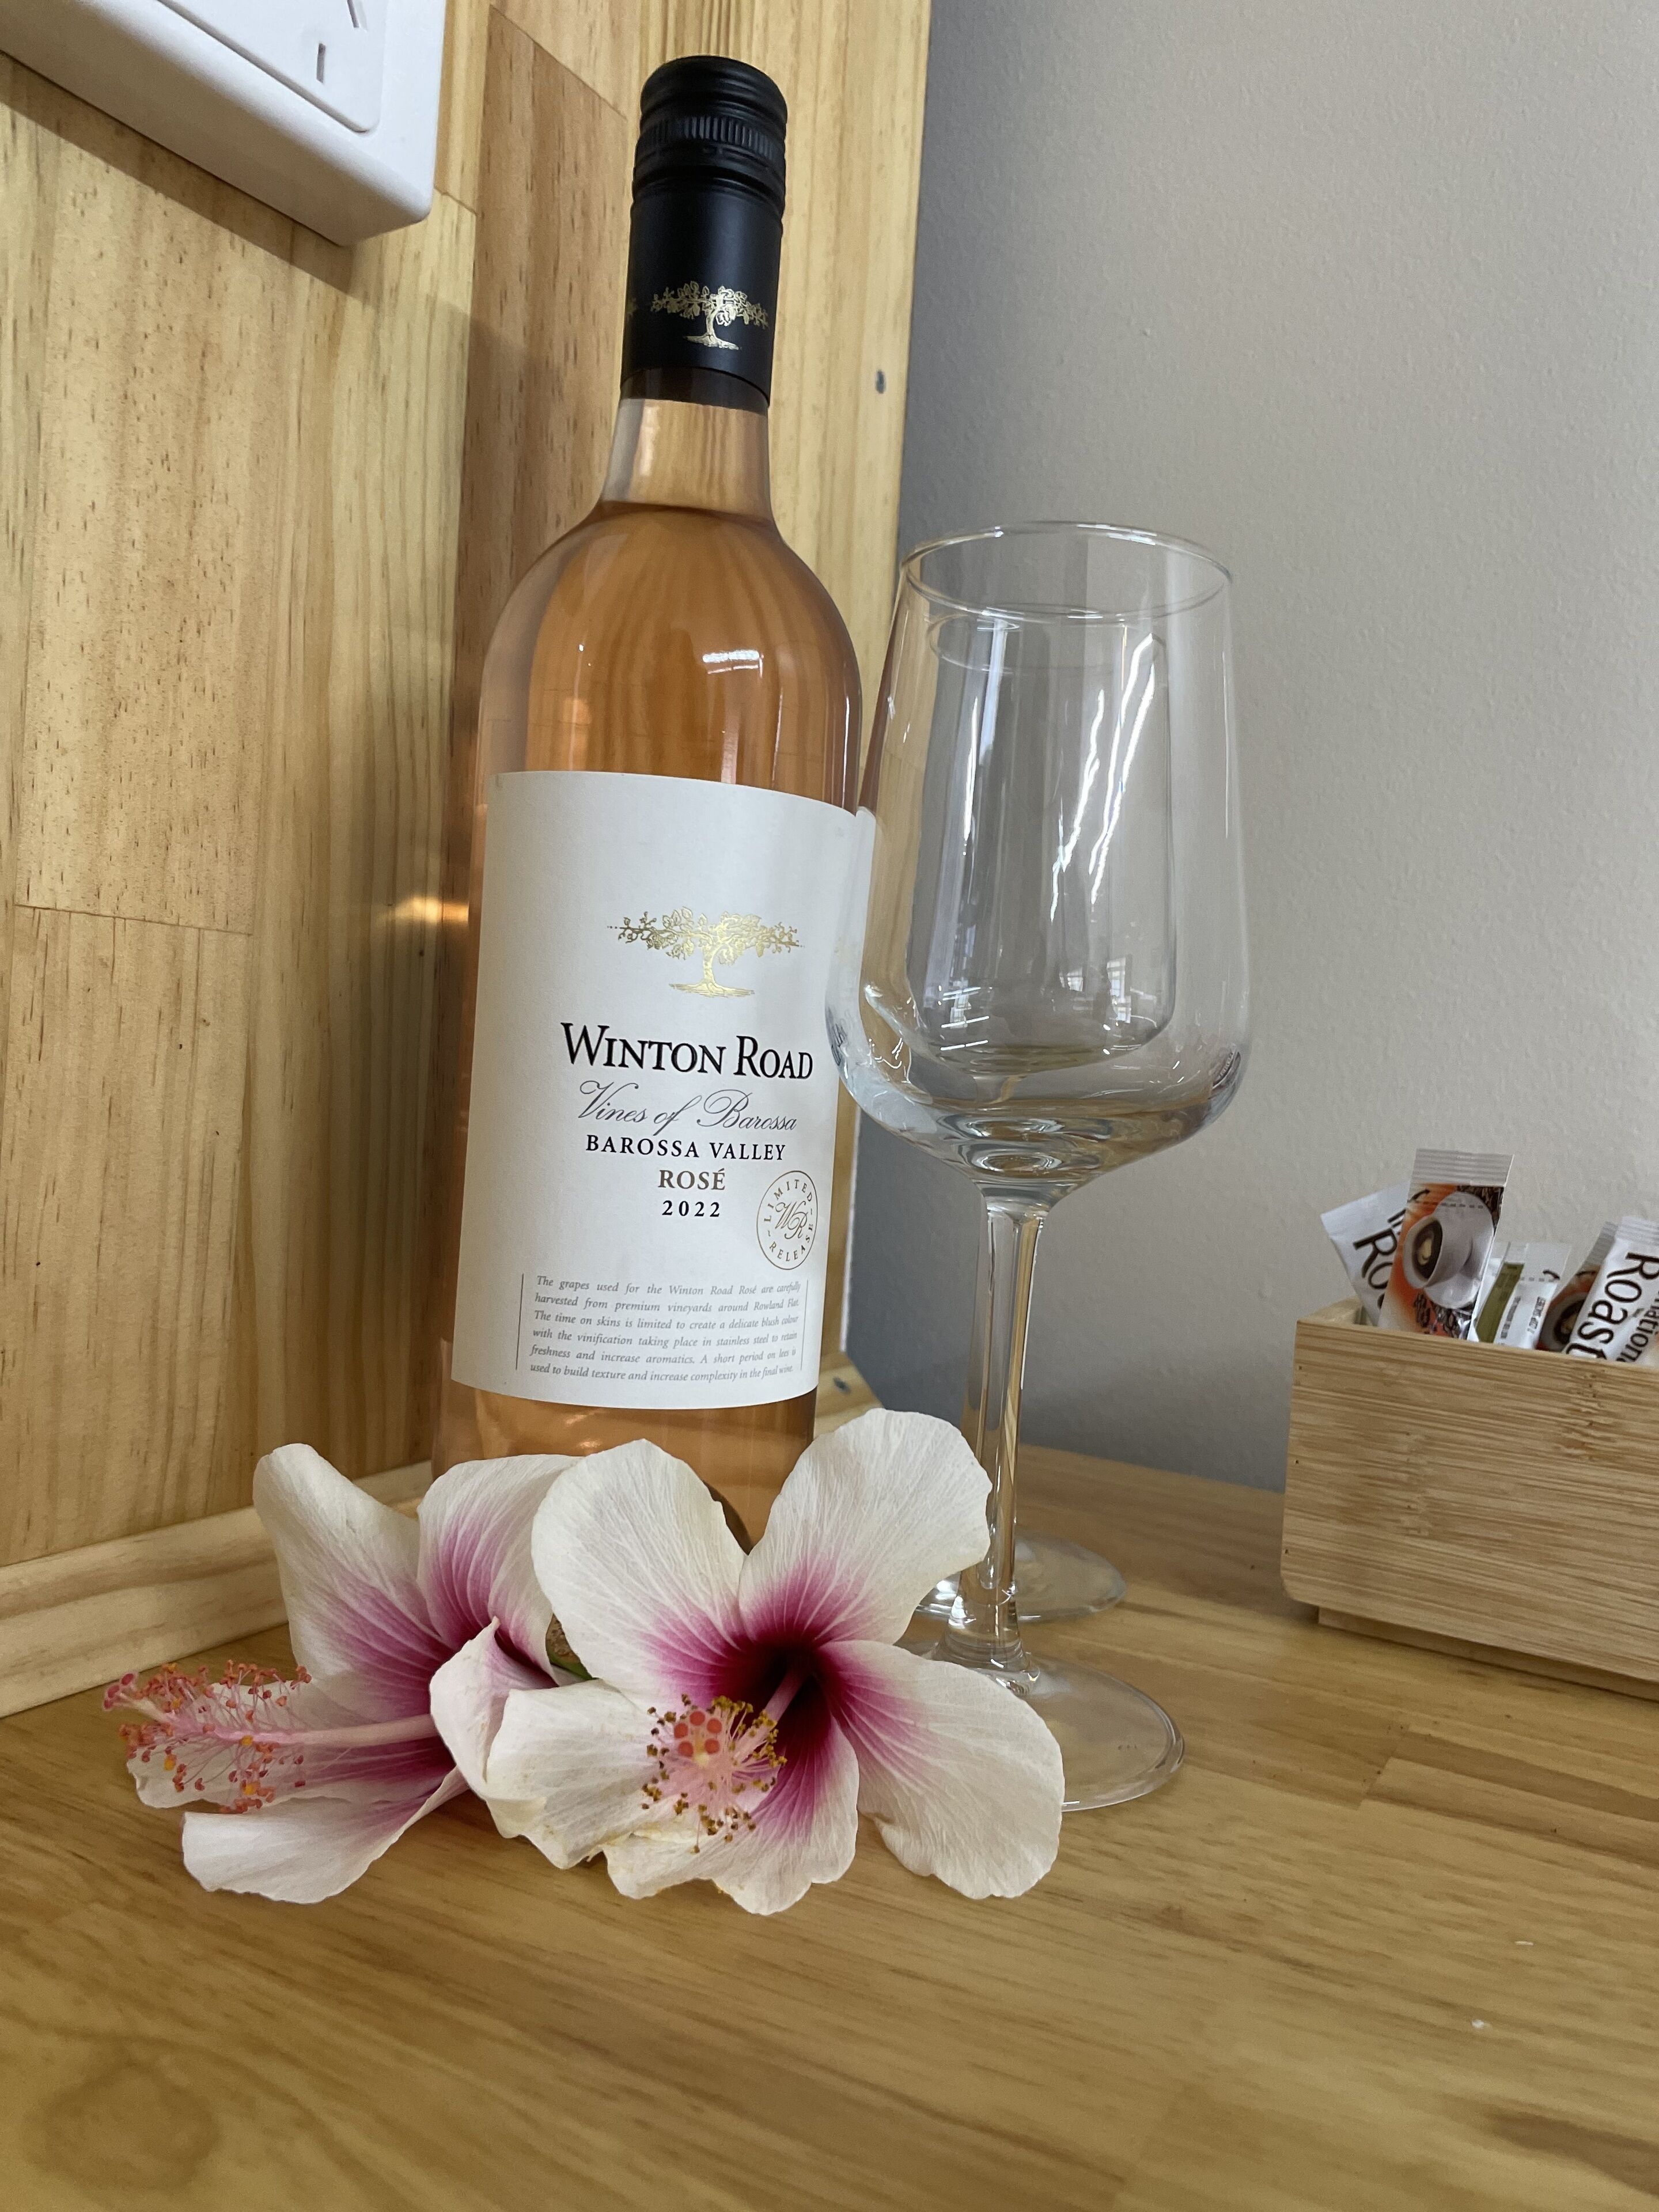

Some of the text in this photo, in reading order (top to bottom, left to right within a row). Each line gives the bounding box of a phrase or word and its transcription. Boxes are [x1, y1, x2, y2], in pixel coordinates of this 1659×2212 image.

[579, 1081, 797, 1136] Vines of Barossa
[586, 1135, 786, 1161] BAROSSA VALLEY
[658, 1168, 726, 1191] ROSÉ
[662, 1200, 721, 1218] 2022
[764, 1180, 812, 1222] LIMITED
[769, 1224, 813, 1262] RELEASE
[537, 1275, 554, 1286] The
[559, 1280, 590, 1291] grapes
[596, 1283, 619, 1291] used
[624, 1283, 640, 1295] for
[647, 1284, 662, 1294] the
[669, 1285, 703, 1295] Winton
[710, 1285, 733, 1295] Road
[738, 1285, 756, 1294] Rosé
[777, 1281, 801, 1294] carefully
[535, 1293, 579, 1306] harvested
[584, 1298, 608, 1310] from
[615, 1301, 660, 1312] premium
[668, 1302, 712, 1315] vineyards
[718, 1302, 748, 1312] around
[753, 1300, 784, 1310] Rowland
[1566, 1252, 1659, 1360] Roast
[535, 1310, 551, 1320] The
[555, 1313, 576, 1323] time
[597, 1317, 620, 1327] skins
[626, 1318, 633, 1327] is
[637, 1319, 672, 1328] limited
[729, 1319, 759, 1328] delicate
[762, 1317, 778, 1327] blush
[782, 1315, 799, 1324] colour
[533, 1328, 552, 1338] with
[558, 1330, 572, 1340] the
[577, 1333, 632, 1345] vinification
[638, 1336, 669, 1349] taking
[673, 1337, 698, 1349] place
[702, 1337, 711, 1346] in
[716, 1336, 749, 1346] stainless
[753, 1334, 769, 1344] steel
[781, 1331, 797, 1341] retain
[529, 1344, 571, 1358] freshness
[576, 1351, 596, 1360] and
[601, 1353, 640, 1362] increase
[646, 1354, 695, 1363] aromatics.
[700, 1354, 707, 1363] A
[713, 1354, 734, 1363] short
[738, 1351, 764, 1365] period
[779, 1349, 789, 1358] lees
[791, 1347, 796, 1355] is
[531, 1363, 551, 1373] used
[564, 1366, 589, 1377] build
[591, 1370, 626, 1380] texture
[628, 1370, 647, 1380] and
[650, 1371, 688, 1381] increase
[691, 1370, 738, 1383] complexity
[739, 1370, 747, 1378] in
[749, 1368, 761, 1378] the
[762, 1365, 778, 1380] final
